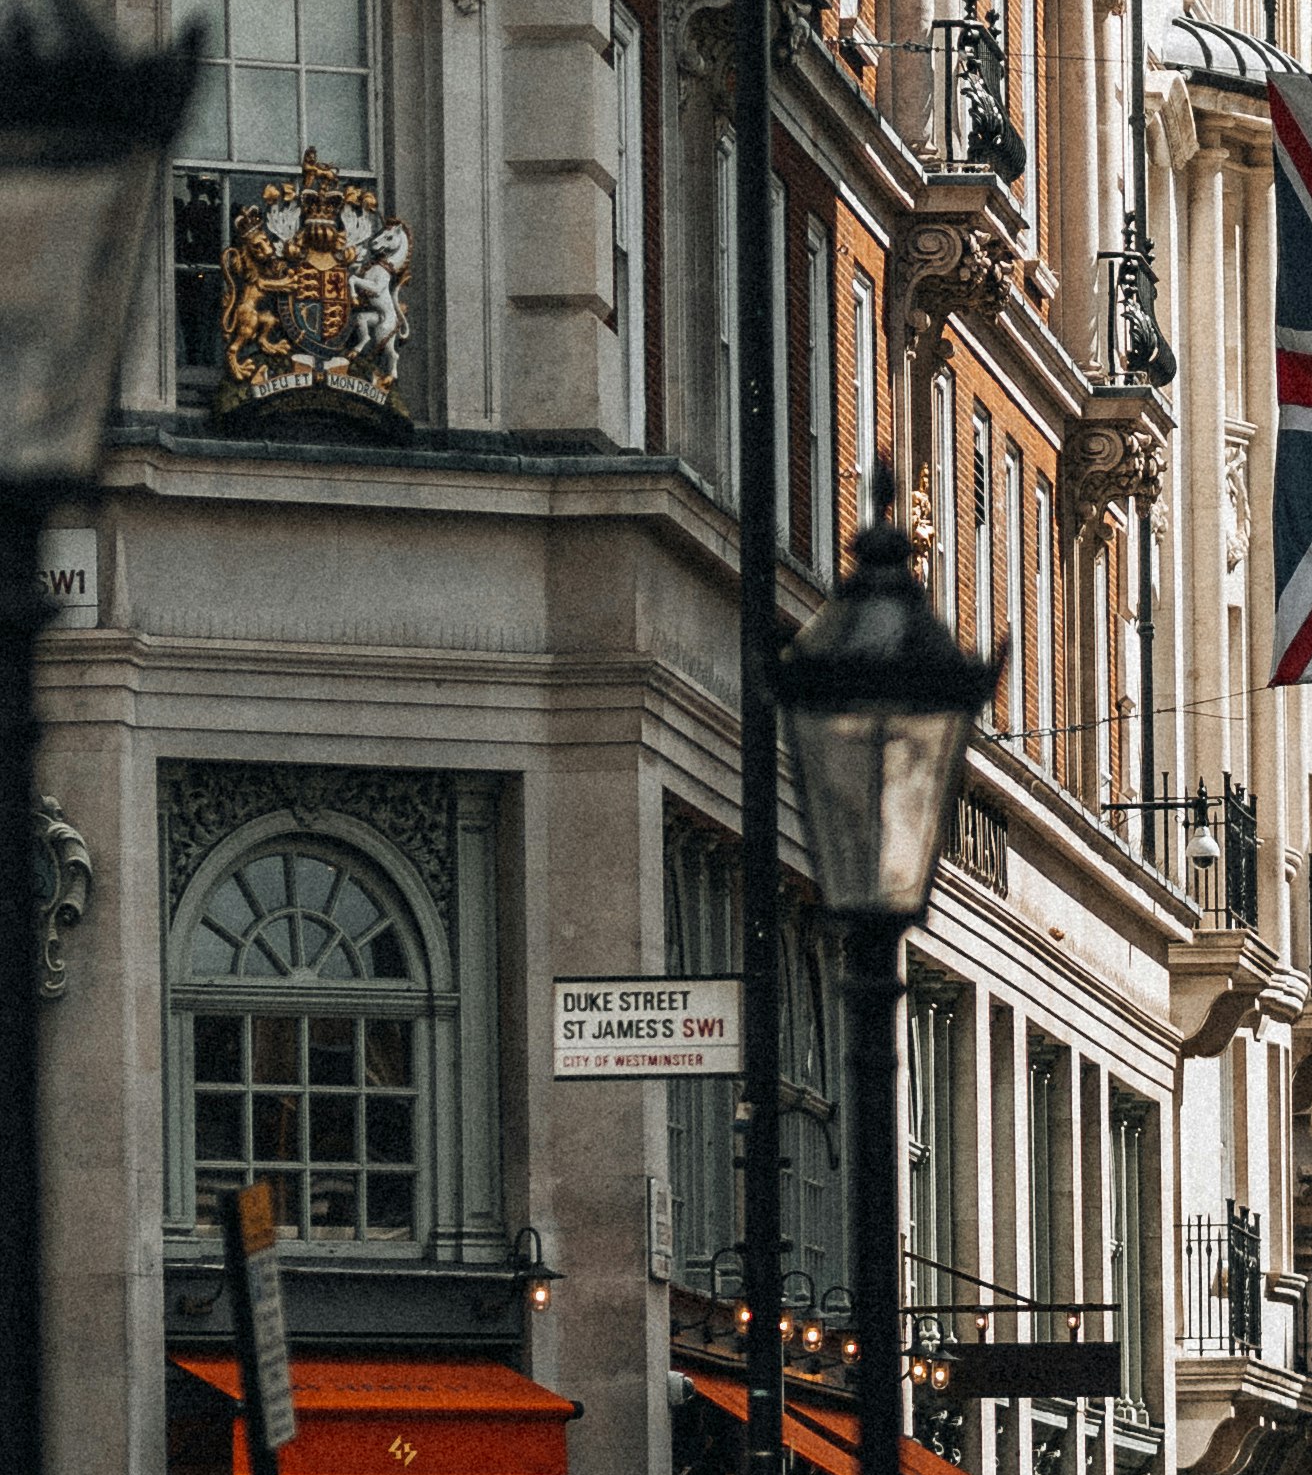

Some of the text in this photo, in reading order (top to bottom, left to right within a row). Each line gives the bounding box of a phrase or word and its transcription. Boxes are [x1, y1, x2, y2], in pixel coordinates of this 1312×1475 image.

[259, 372, 310, 396] DIEU ET
[330, 374, 355, 391] MON
[563, 990, 691, 1012] DUKE STREET
[563, 1018, 724, 1040] ST JAMES'S SW1
[562, 1053, 703, 1068] CITY OF WESTMINSTER
